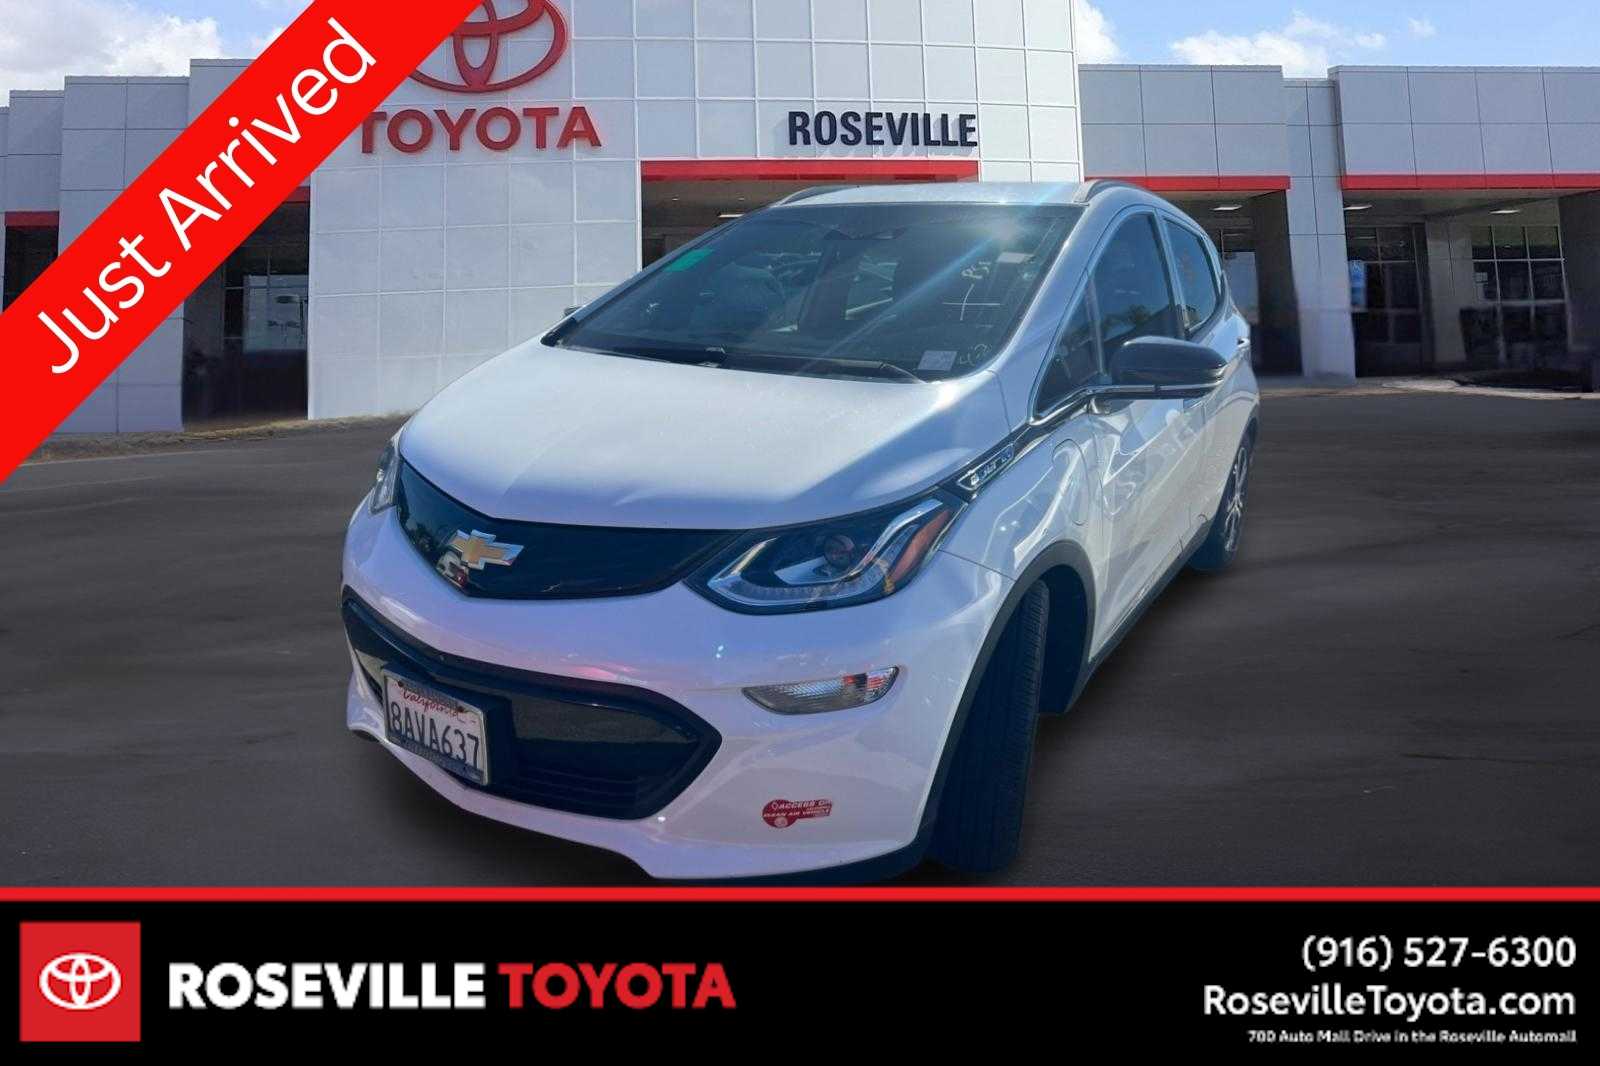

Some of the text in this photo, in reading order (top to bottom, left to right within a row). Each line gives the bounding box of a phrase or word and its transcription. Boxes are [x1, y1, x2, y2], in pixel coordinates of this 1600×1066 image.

[362, 107, 602, 153] TOYOTA
[788, 110, 978, 147] ROSEVILLE
[390, 700, 480, 769] 8AVA637
